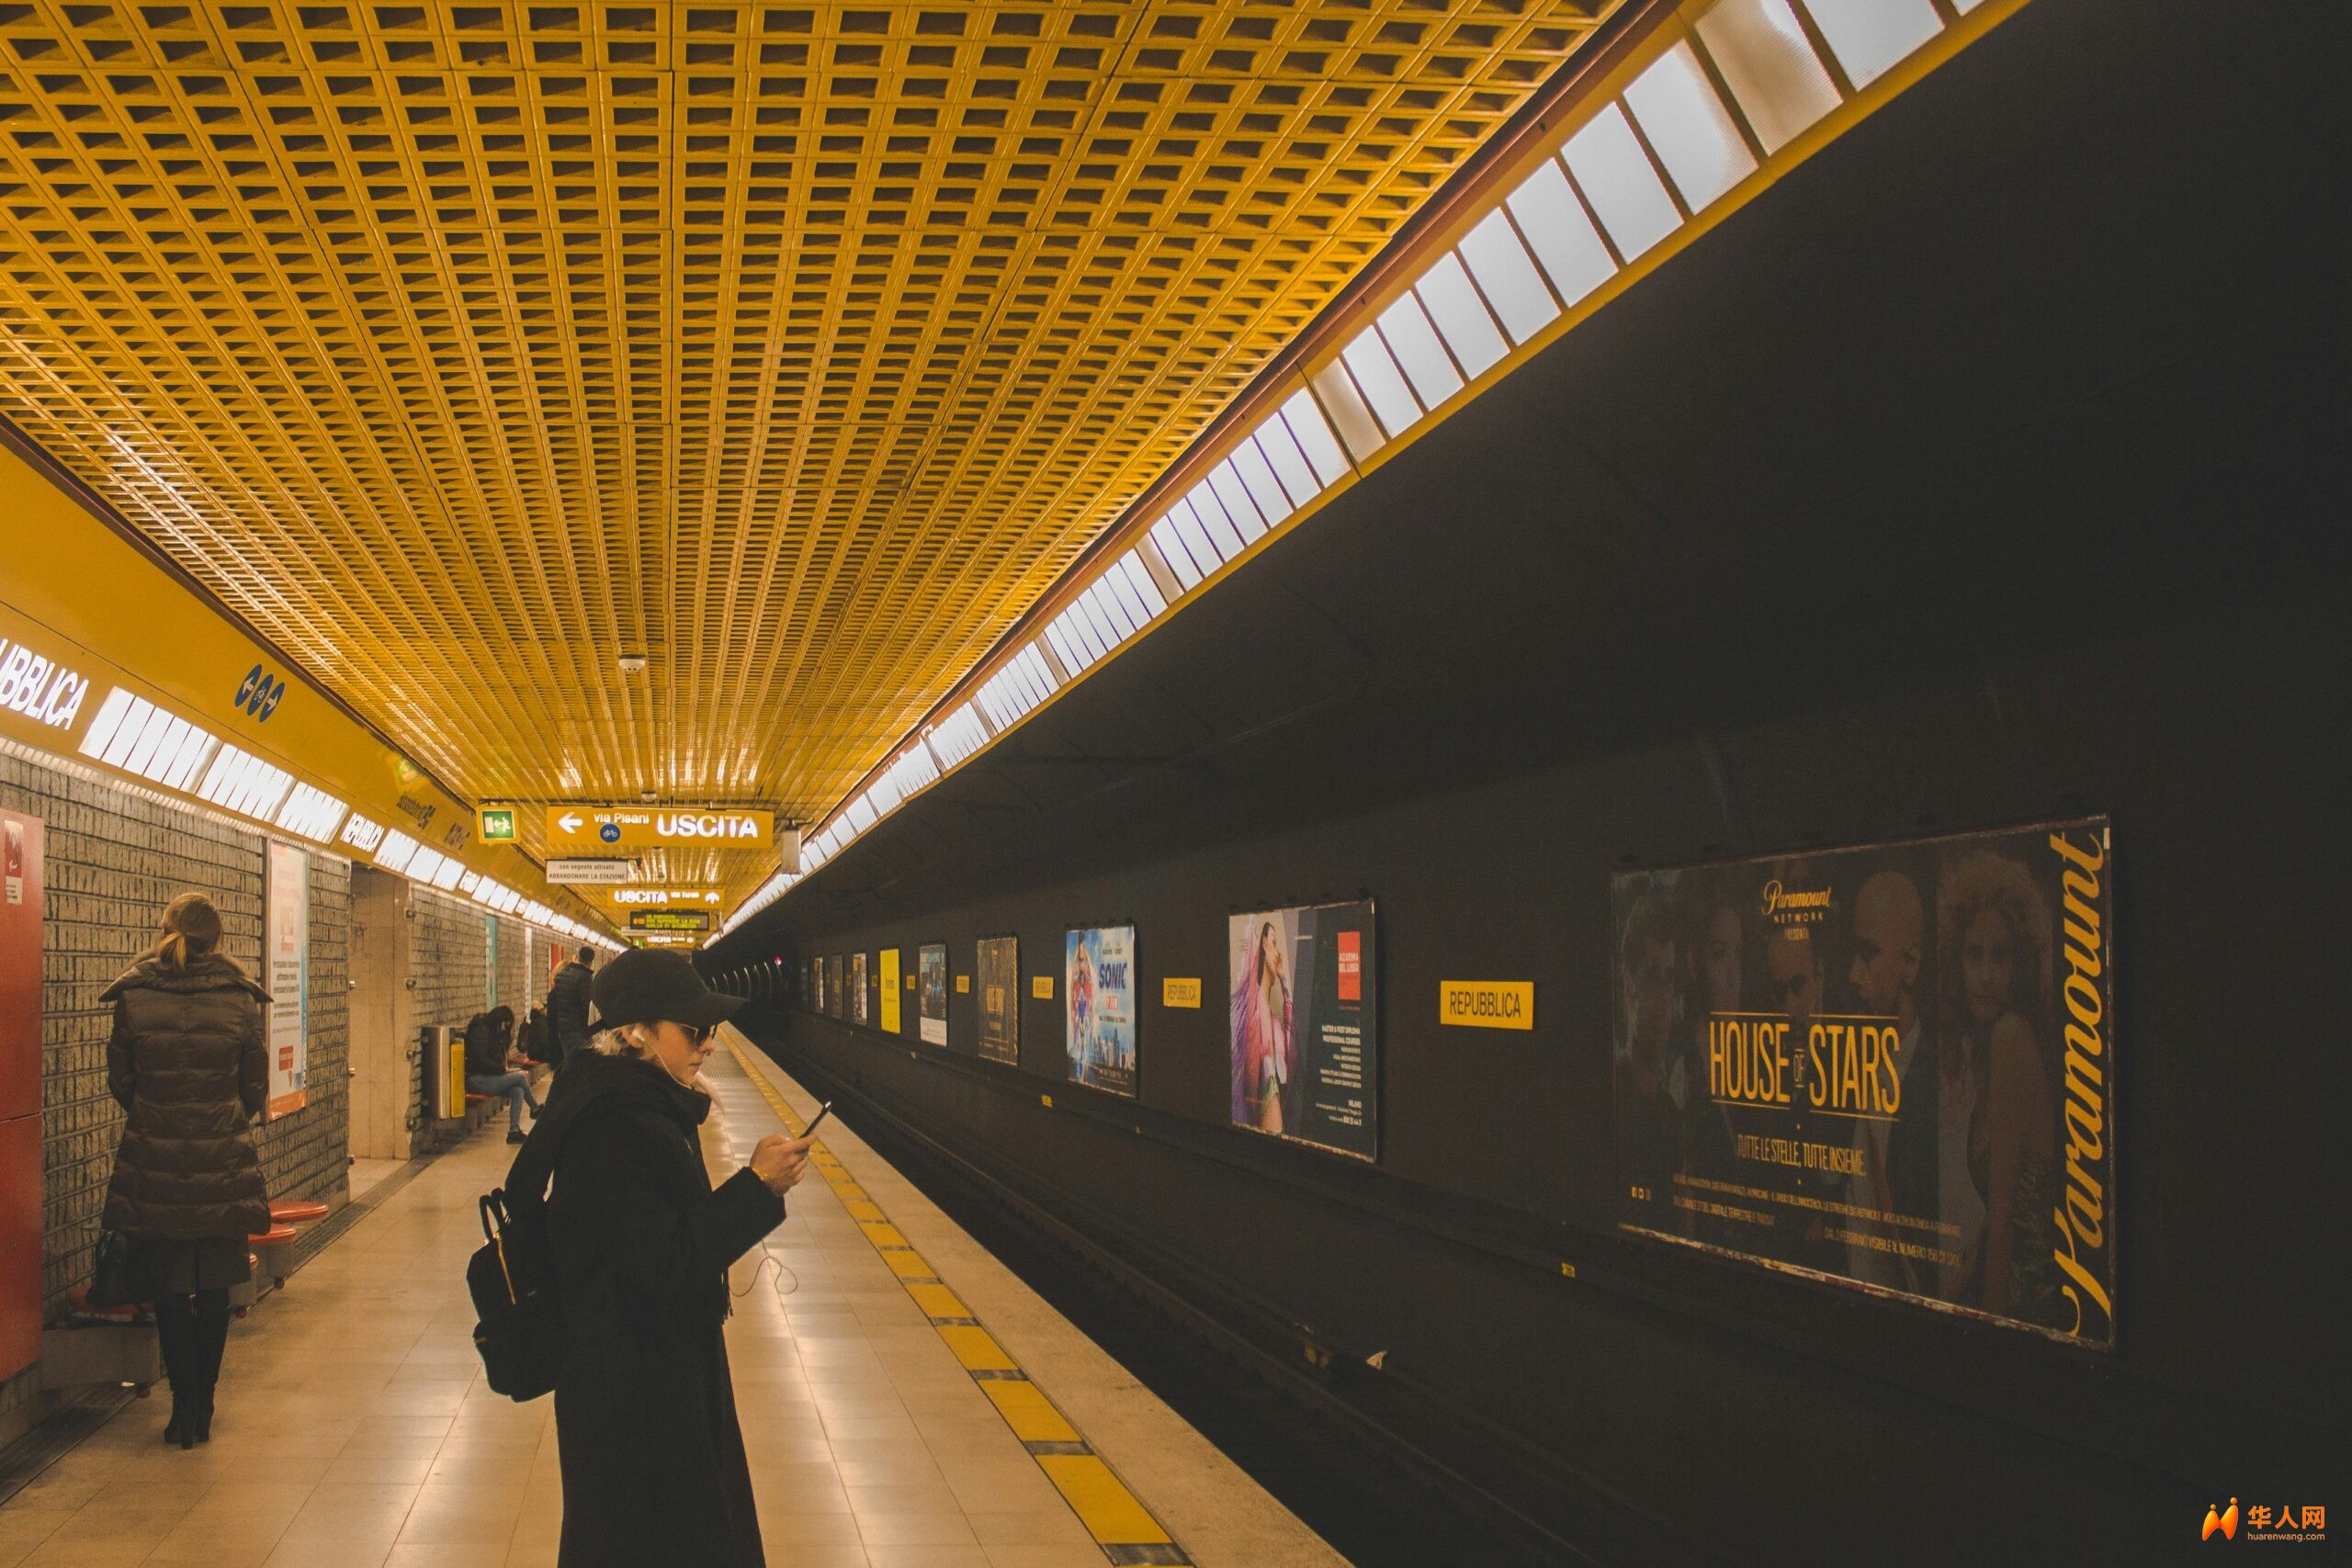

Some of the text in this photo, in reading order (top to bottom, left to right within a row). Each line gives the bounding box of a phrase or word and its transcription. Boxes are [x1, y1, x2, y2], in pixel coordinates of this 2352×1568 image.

[594, 812, 759, 839] via Pisani USCITA
[614, 890, 668, 904] USCITA
[1761, 879, 1833, 916] Paramount
[1773, 910, 1824, 924] NETWORK
[1099, 962, 1127, 989] SONIC
[1450, 991, 1521, 1018] REPUBBLICA
[1710, 1021, 1791, 1102] HOUSE
[1809, 1023, 1901, 1114] STARS
[2049, 831, 2111, 1337] Paramount
[1737, 1134, 1759, 1161] TUTTE
[1760, 1137, 1770, 1162] LE
[1803, 1142, 1828, 1171] TUTTE
